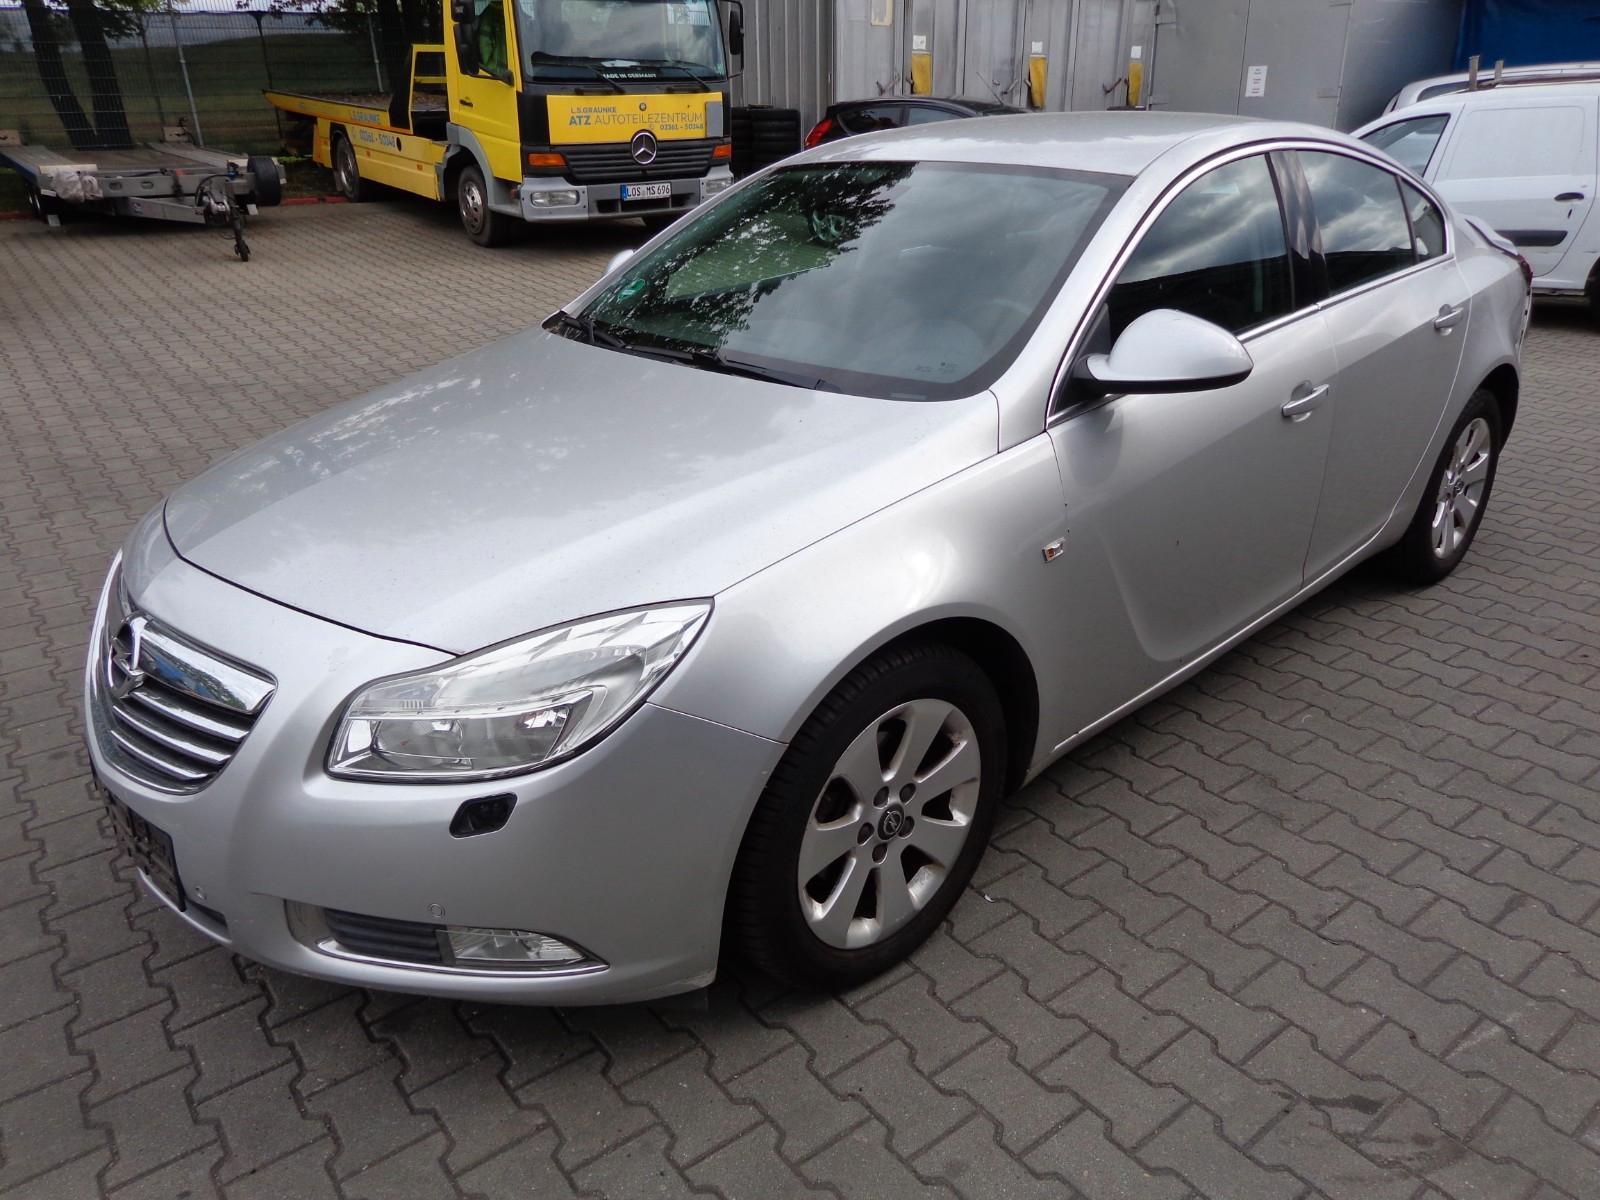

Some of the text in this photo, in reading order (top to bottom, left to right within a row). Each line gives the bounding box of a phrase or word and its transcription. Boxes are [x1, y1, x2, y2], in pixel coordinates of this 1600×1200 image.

[569, 112, 703, 126] ATZ AUTOTEILEZENTRUM
[627, 185, 670, 197] LOS MS 696
